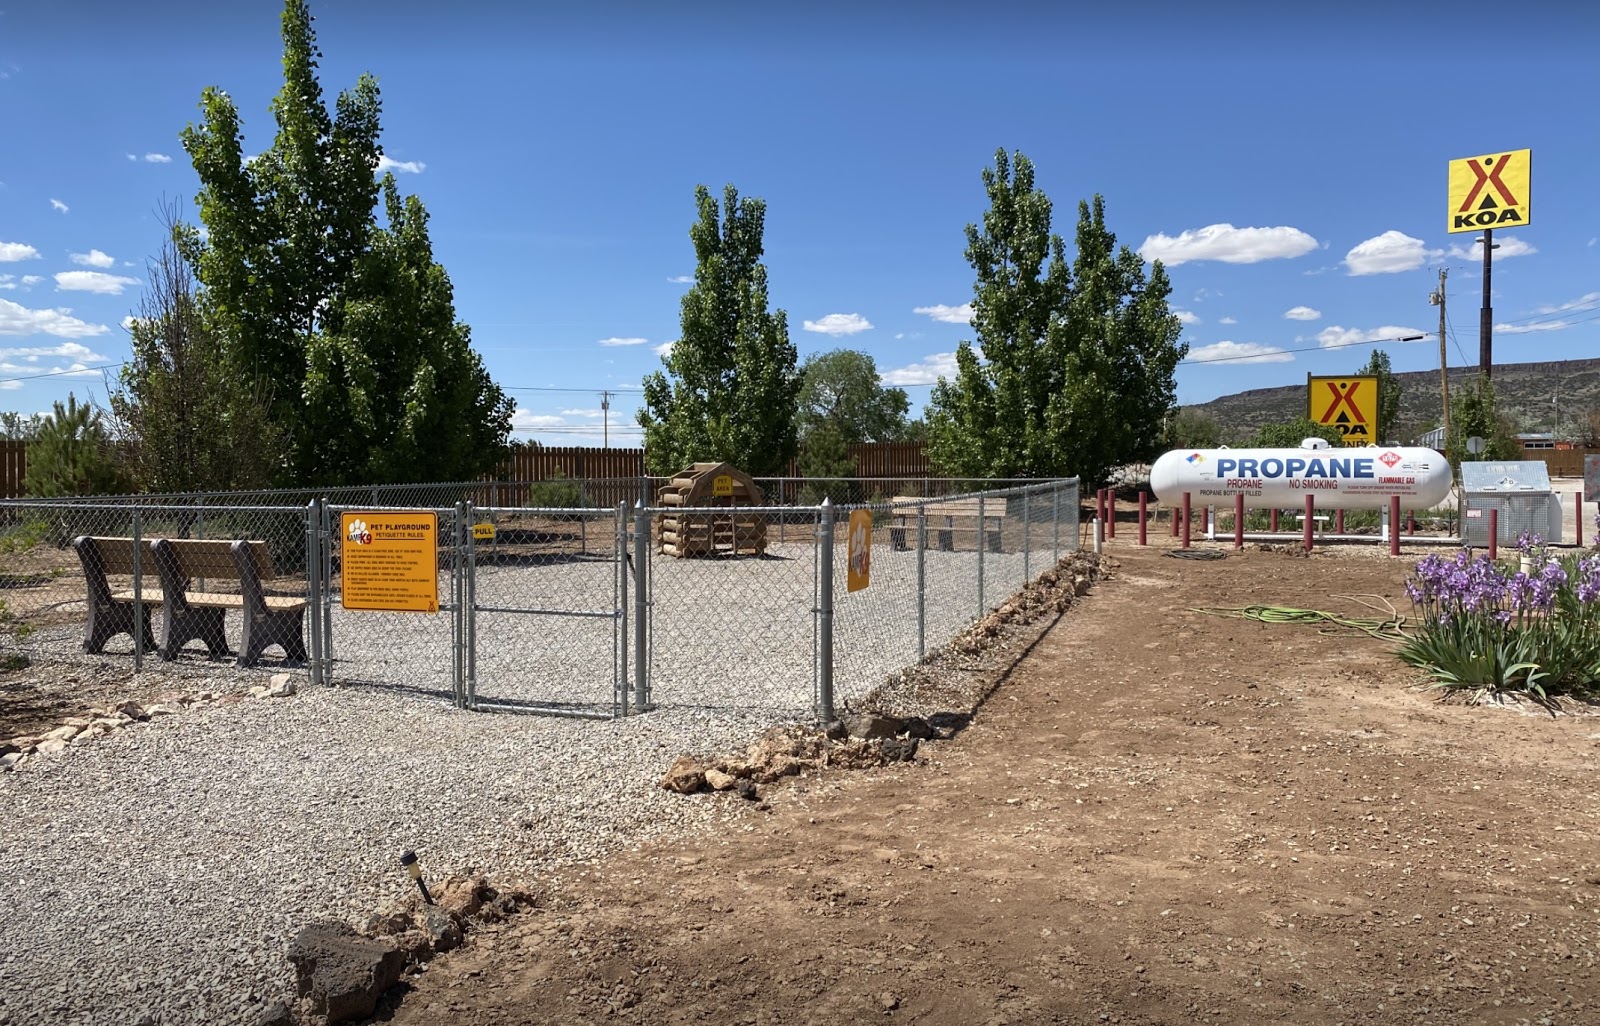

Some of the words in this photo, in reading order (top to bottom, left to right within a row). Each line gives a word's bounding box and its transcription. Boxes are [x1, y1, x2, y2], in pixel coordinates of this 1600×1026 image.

[1454, 208, 1522, 229] KOA
[1335, 424, 1368, 435] OA
[1217, 458, 1374, 478] PROPANE
[1227, 479, 1263, 489] PROPANE
[1289, 479, 1301, 489] NO
[1302, 479, 1338, 489] SMOKING
[1378, 476, 1405, 484] FLAMMABLE
[1406, 476, 1415, 485] GAS
